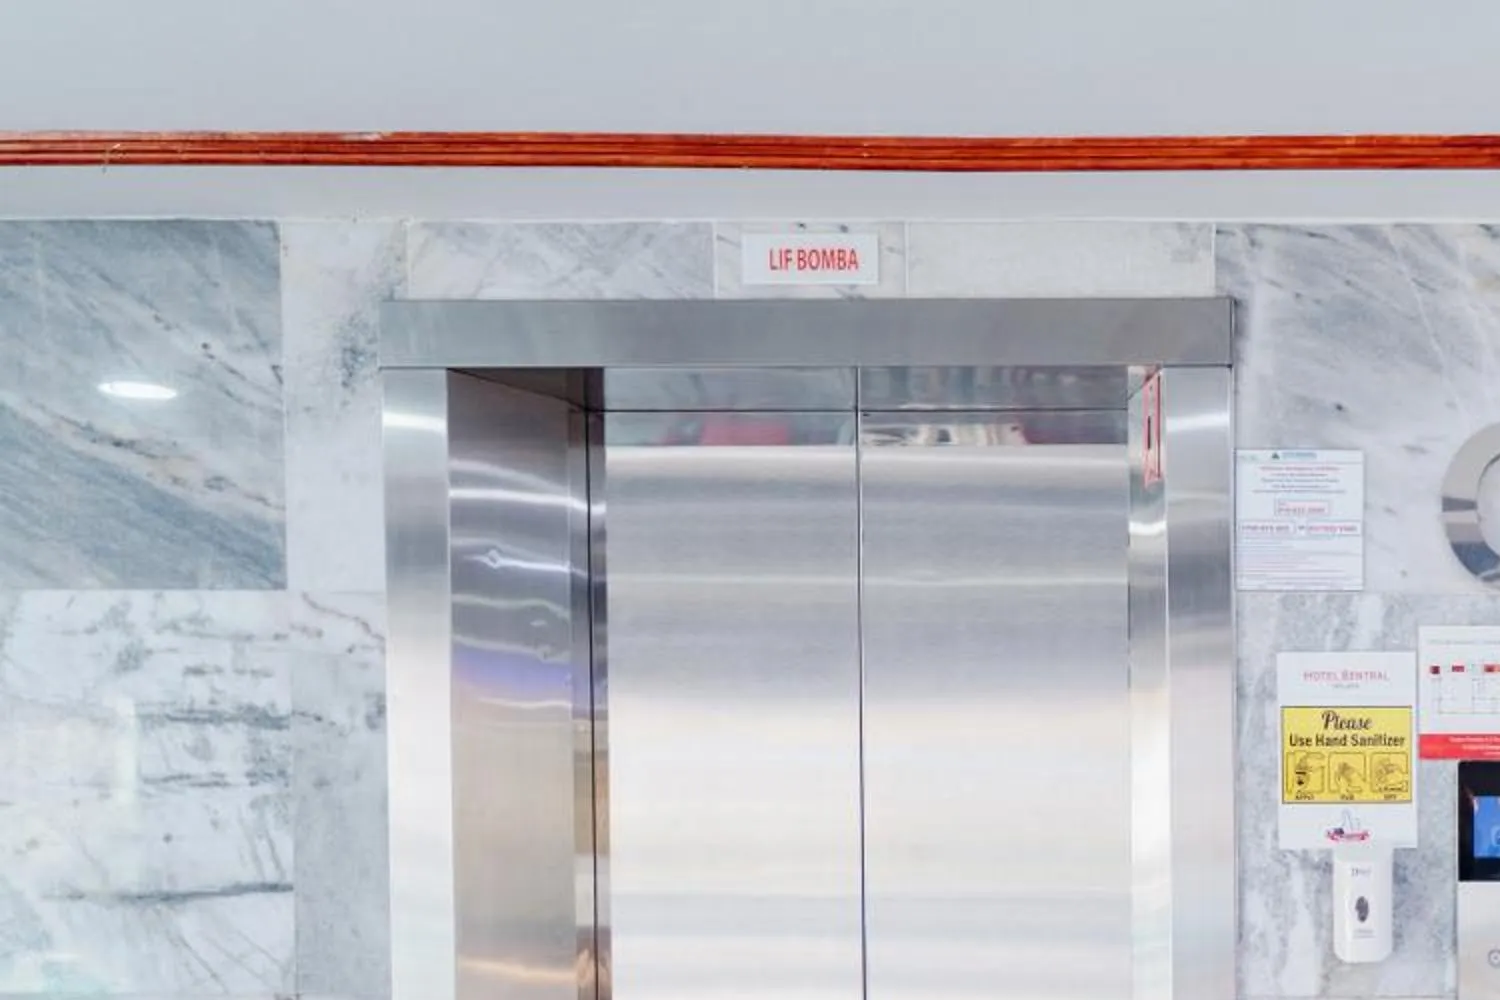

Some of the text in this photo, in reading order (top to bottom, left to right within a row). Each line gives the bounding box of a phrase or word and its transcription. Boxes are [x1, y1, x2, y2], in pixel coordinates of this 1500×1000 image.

[769, 248, 859, 271] LIF BOMBA
[1303, 670, 1339, 682] HOTEL
[1321, 709, 1374, 731] Please
[1289, 734, 1405, 747] Use Hand Sanitizer
